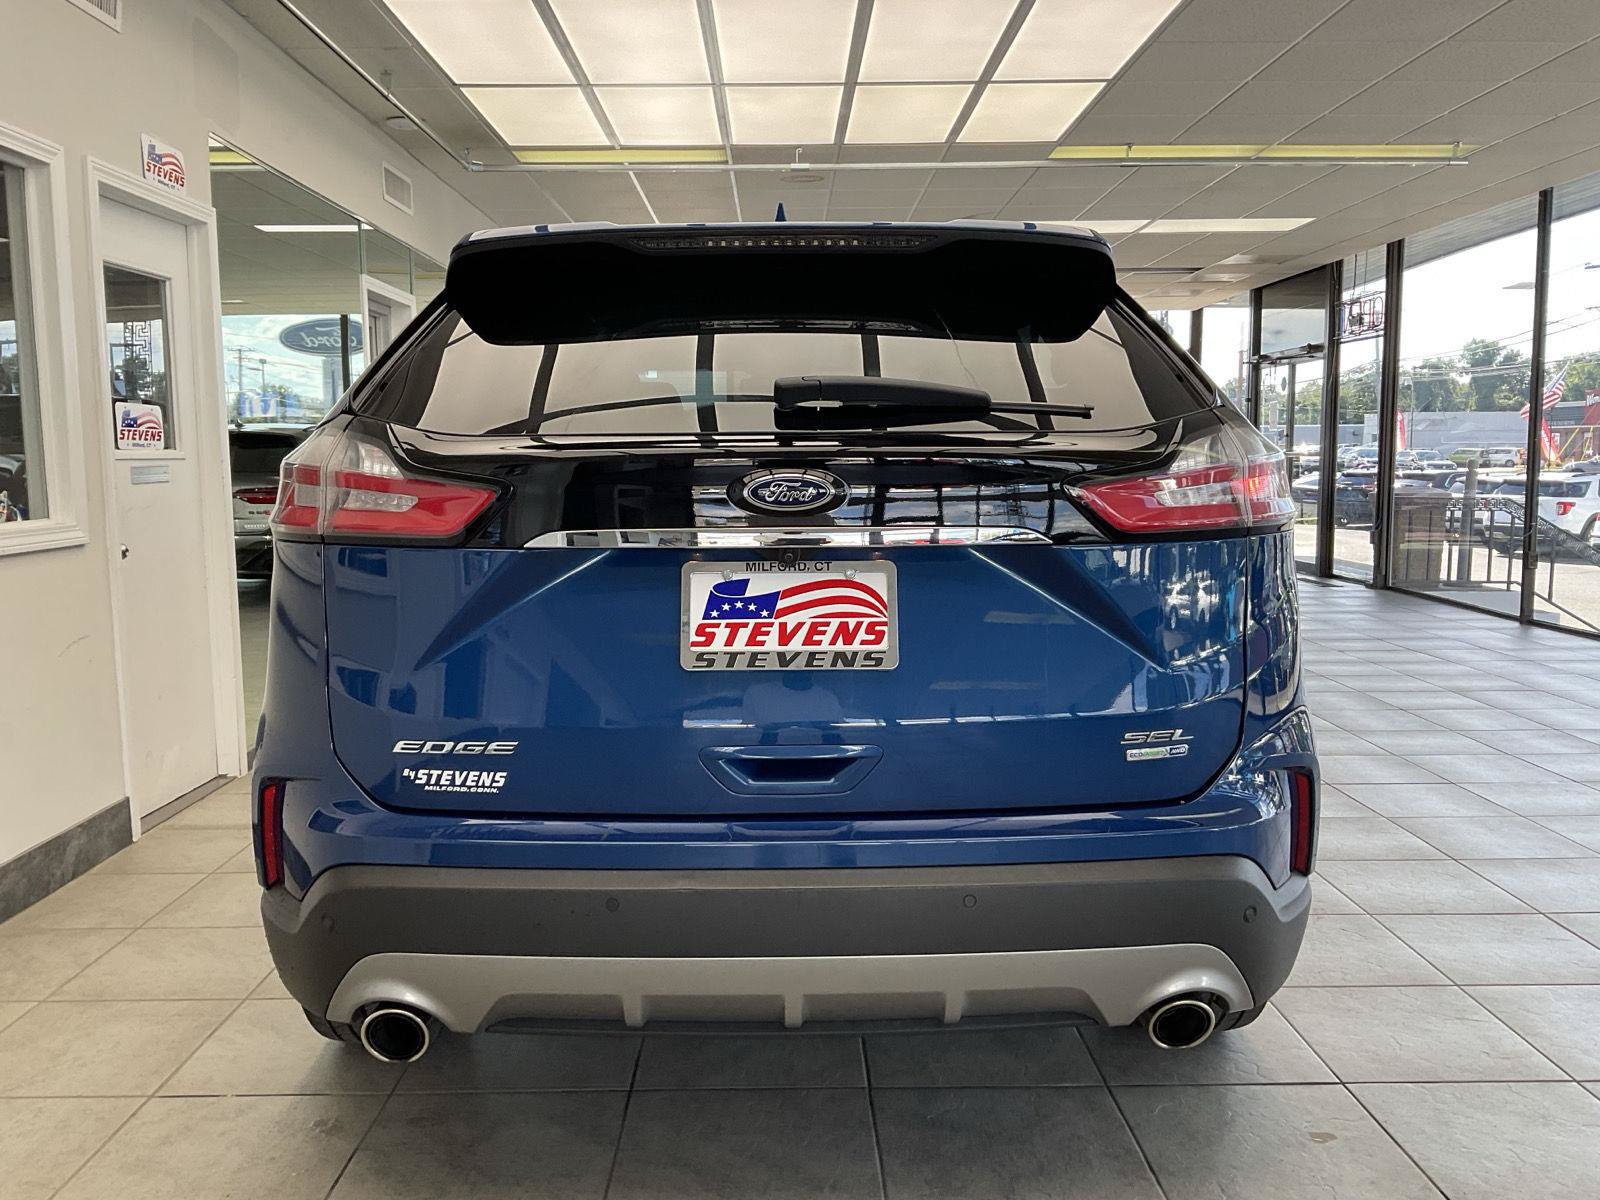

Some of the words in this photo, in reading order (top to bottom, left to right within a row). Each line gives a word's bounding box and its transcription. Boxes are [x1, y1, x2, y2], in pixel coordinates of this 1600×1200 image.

[145, 160, 185, 188] STEVENS
[119, 429, 162, 441] STEVENS
[765, 481, 817, 502] Ford
[814, 561, 832, 571] CT
[690, 621, 888, 647] STEVENS
[692, 651, 886, 668] STEVENS
[1120, 729, 1194, 744] SEL
[392, 740, 519, 754] EDGE
[415, 769, 508, 787] STEVENS
